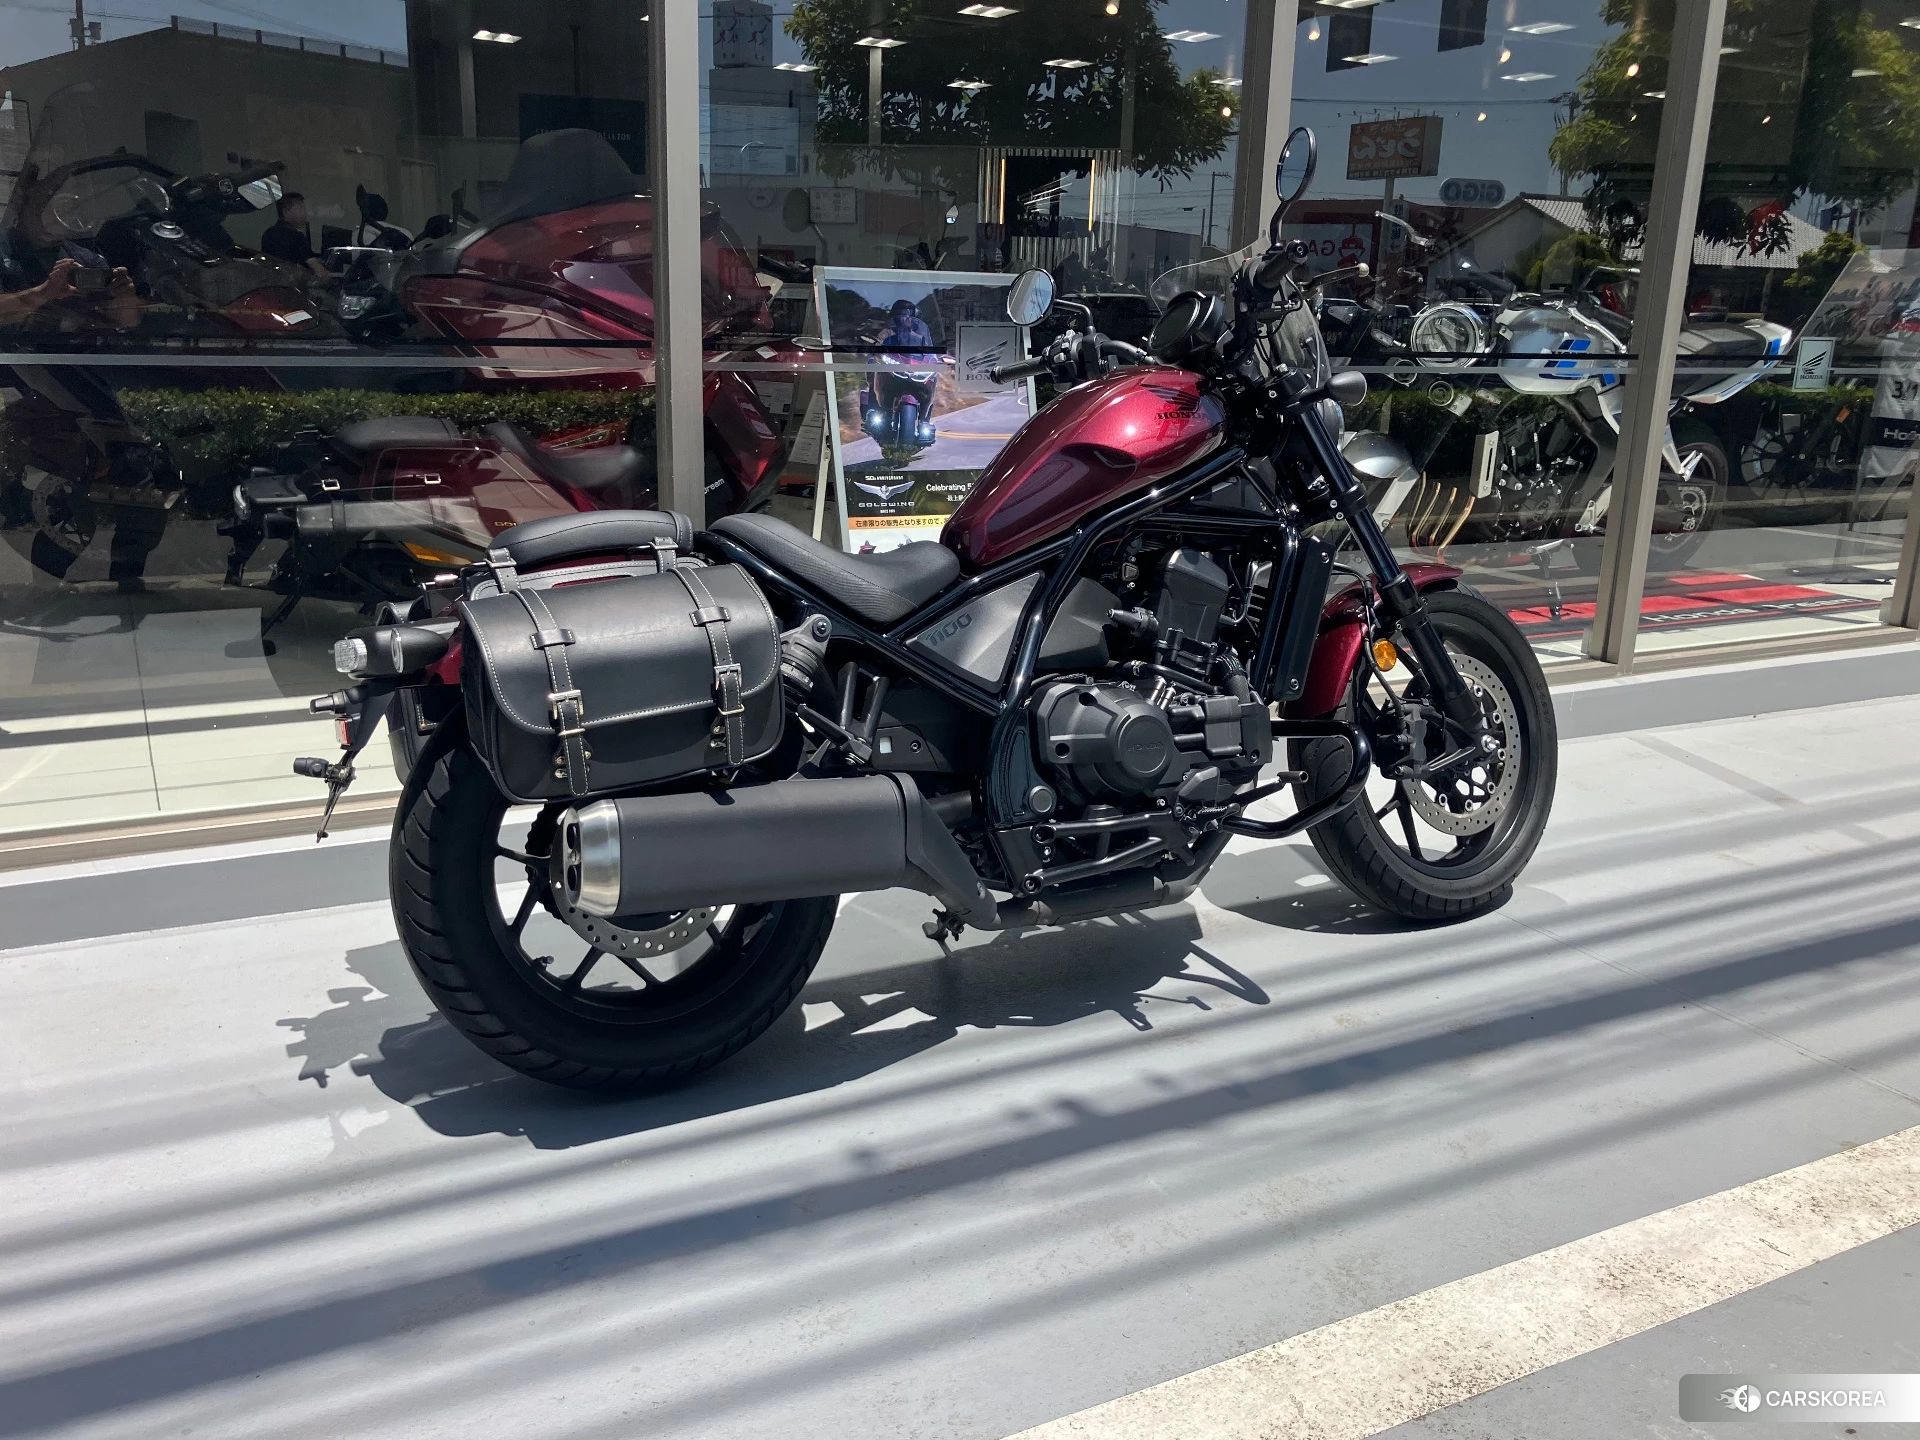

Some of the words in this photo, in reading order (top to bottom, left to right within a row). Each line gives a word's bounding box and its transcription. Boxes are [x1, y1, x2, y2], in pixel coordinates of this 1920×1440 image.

[965, 373, 992, 381] HON
[1156, 411, 1209, 420] HONDA
[925, 482, 966, 492] Celebrating
[1642, 608, 1760, 622] Honda
[926, 612, 973, 646] 1100
